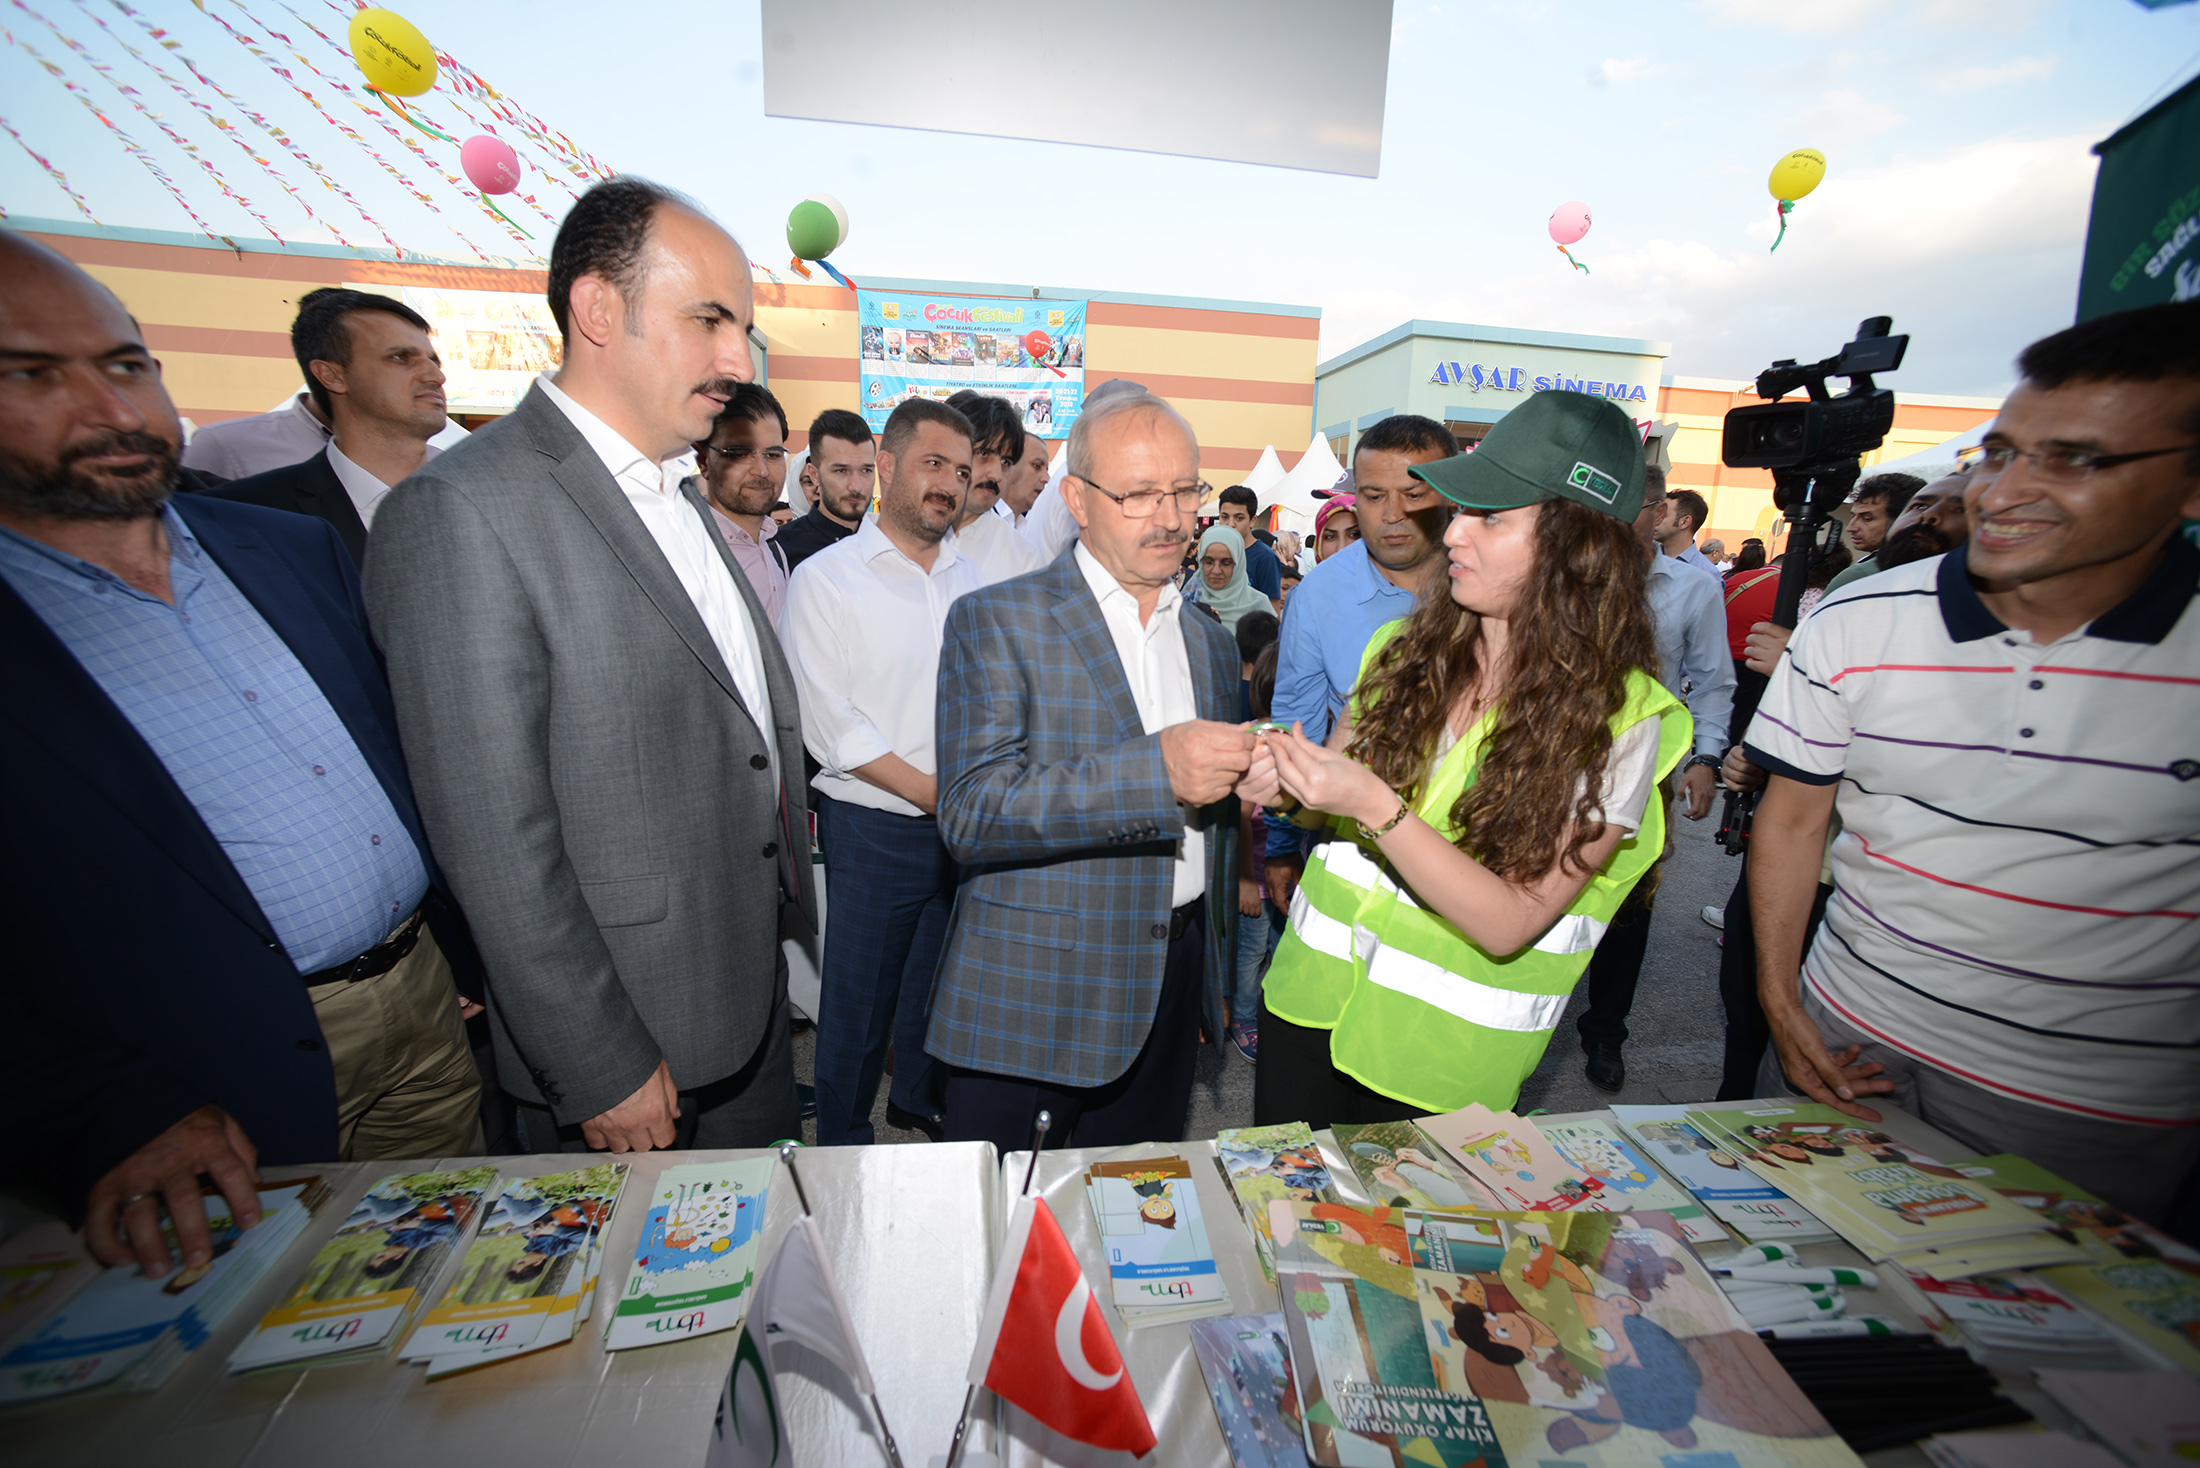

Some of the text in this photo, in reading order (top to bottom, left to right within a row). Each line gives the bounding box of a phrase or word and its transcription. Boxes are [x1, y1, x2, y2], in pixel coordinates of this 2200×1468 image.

[1429, 360, 1648, 402] AVŞAR SİNEMA
[1148, 1281, 1194, 1299] tbm
[300, 1318, 363, 1344] tbm
[655, 1311, 706, 1333] tbm
[453, 1323, 510, 1346] tbm
[1341, 1416, 1495, 1446] KİTAP OKUYORUM
